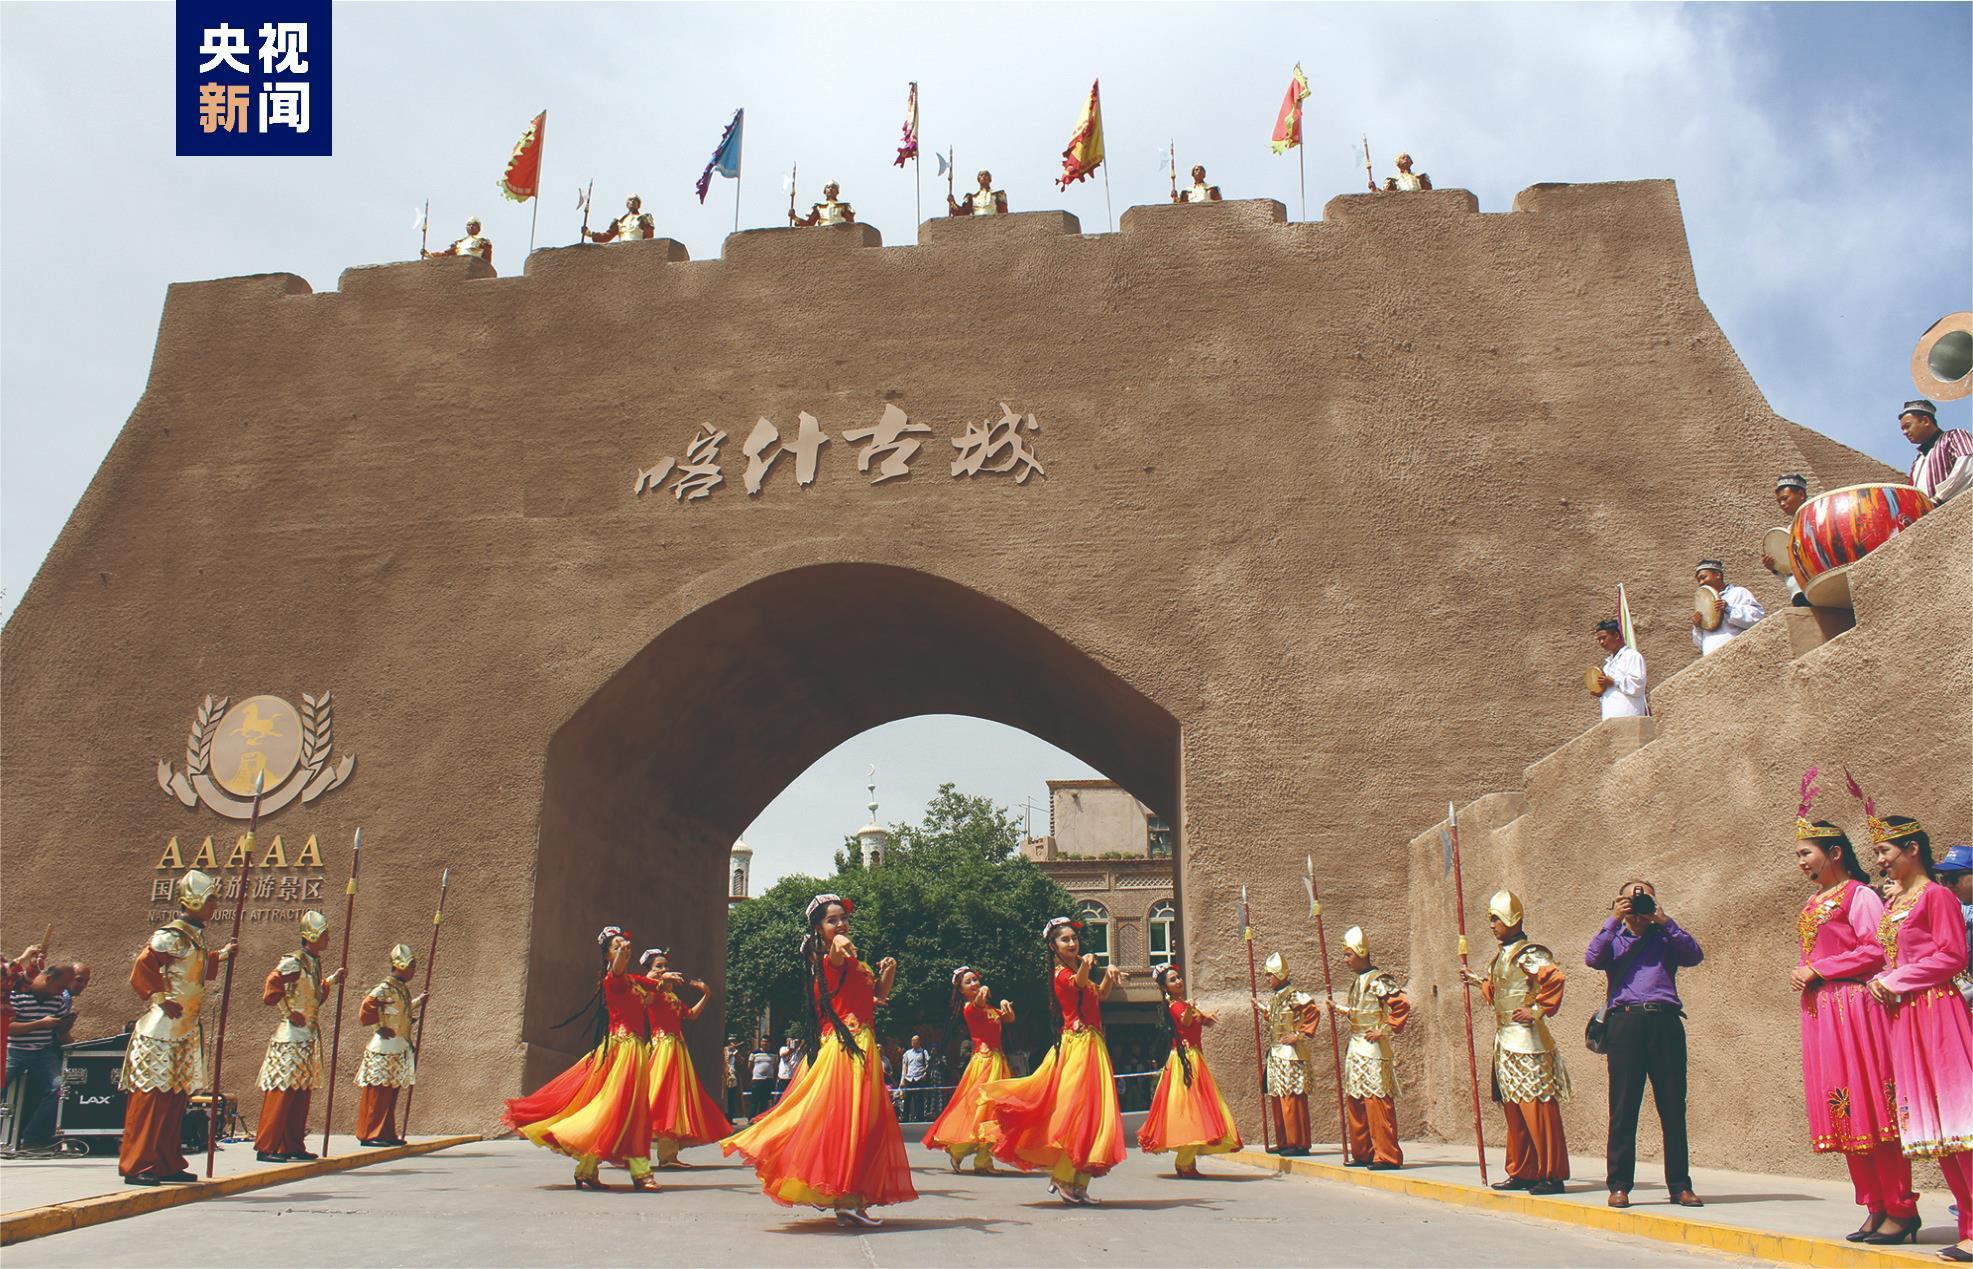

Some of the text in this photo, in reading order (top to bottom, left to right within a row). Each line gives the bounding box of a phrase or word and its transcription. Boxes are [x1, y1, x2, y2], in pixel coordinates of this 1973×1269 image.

[633, 402, 1046, 501] 喀什古城
[155, 834, 325, 870] AAAAA
[151, 876, 324, 901] 国旅游景区
[79, 1095, 111, 1105] LAX
